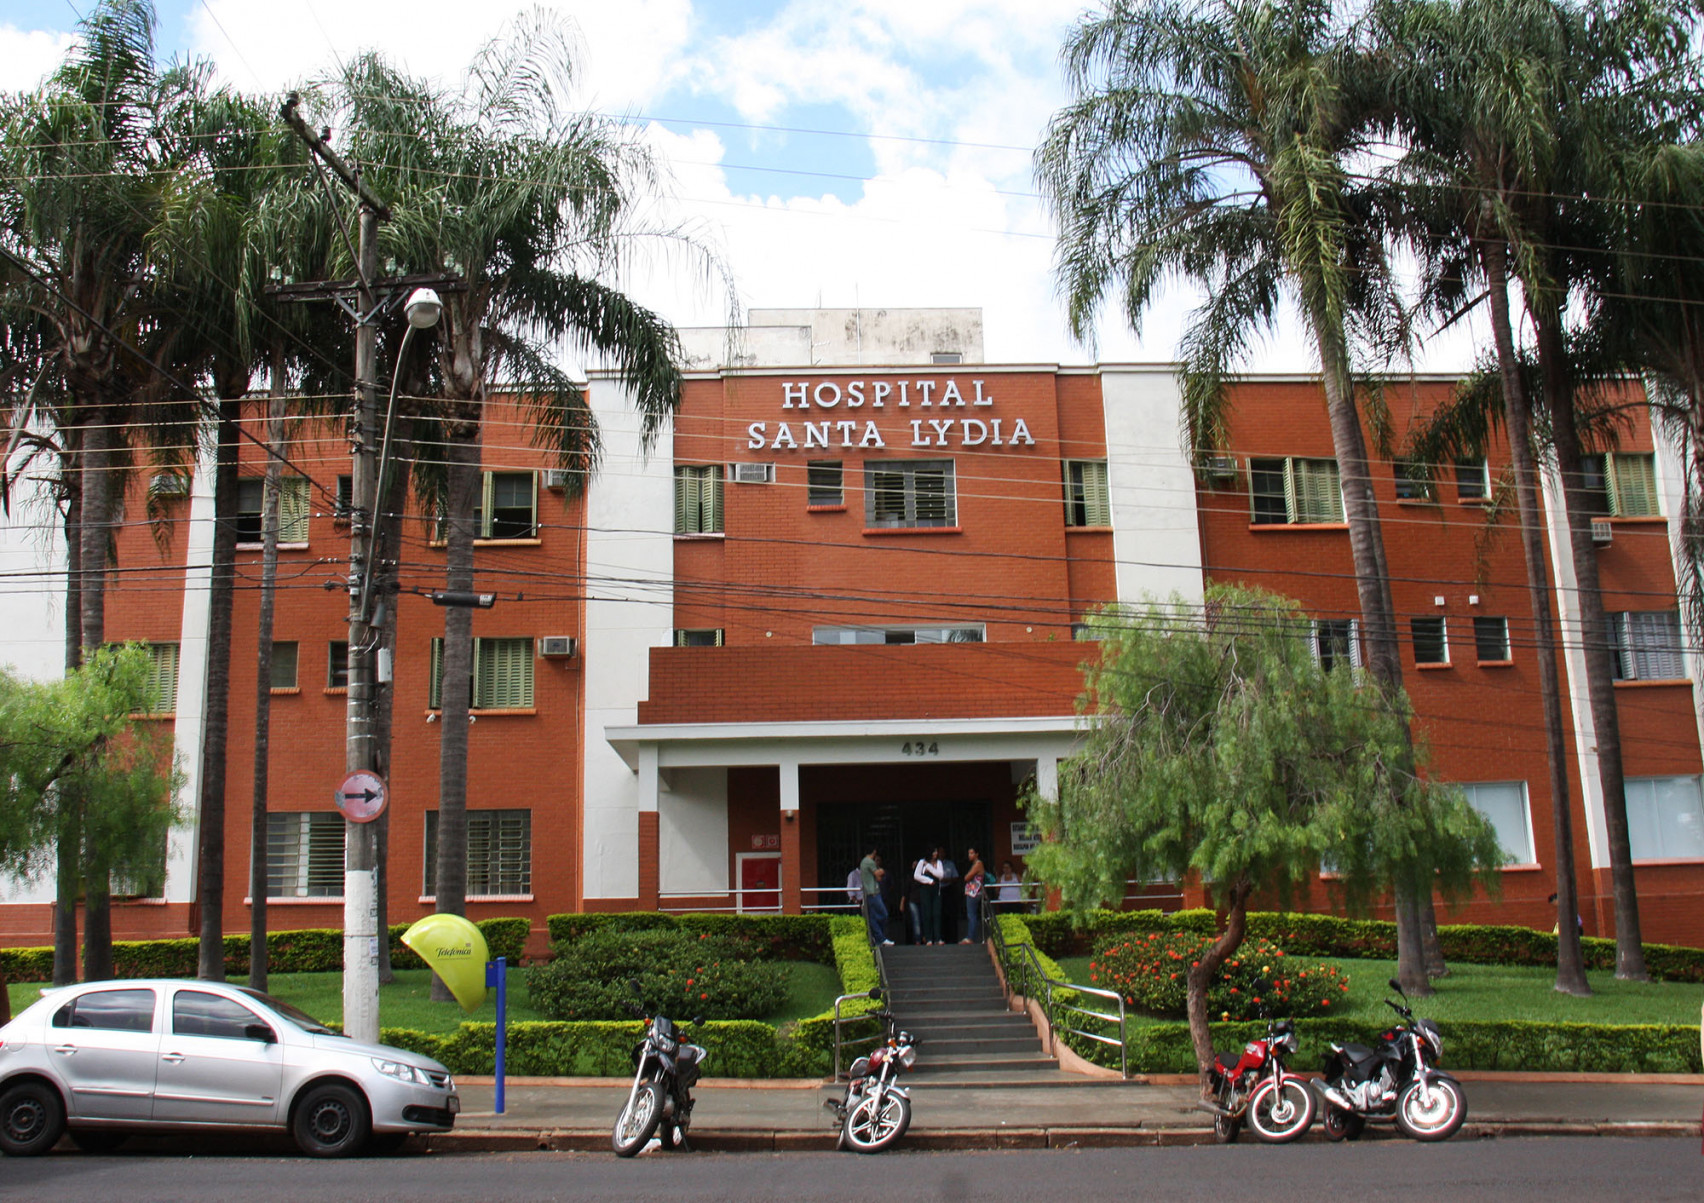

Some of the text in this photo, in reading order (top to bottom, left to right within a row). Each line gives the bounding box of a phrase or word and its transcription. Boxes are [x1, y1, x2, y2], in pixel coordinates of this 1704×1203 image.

[782, 380, 993, 409] HOSPITAL
[748, 418, 1035, 449] SANTA LYDIA
[901, 742, 939, 756] 434
